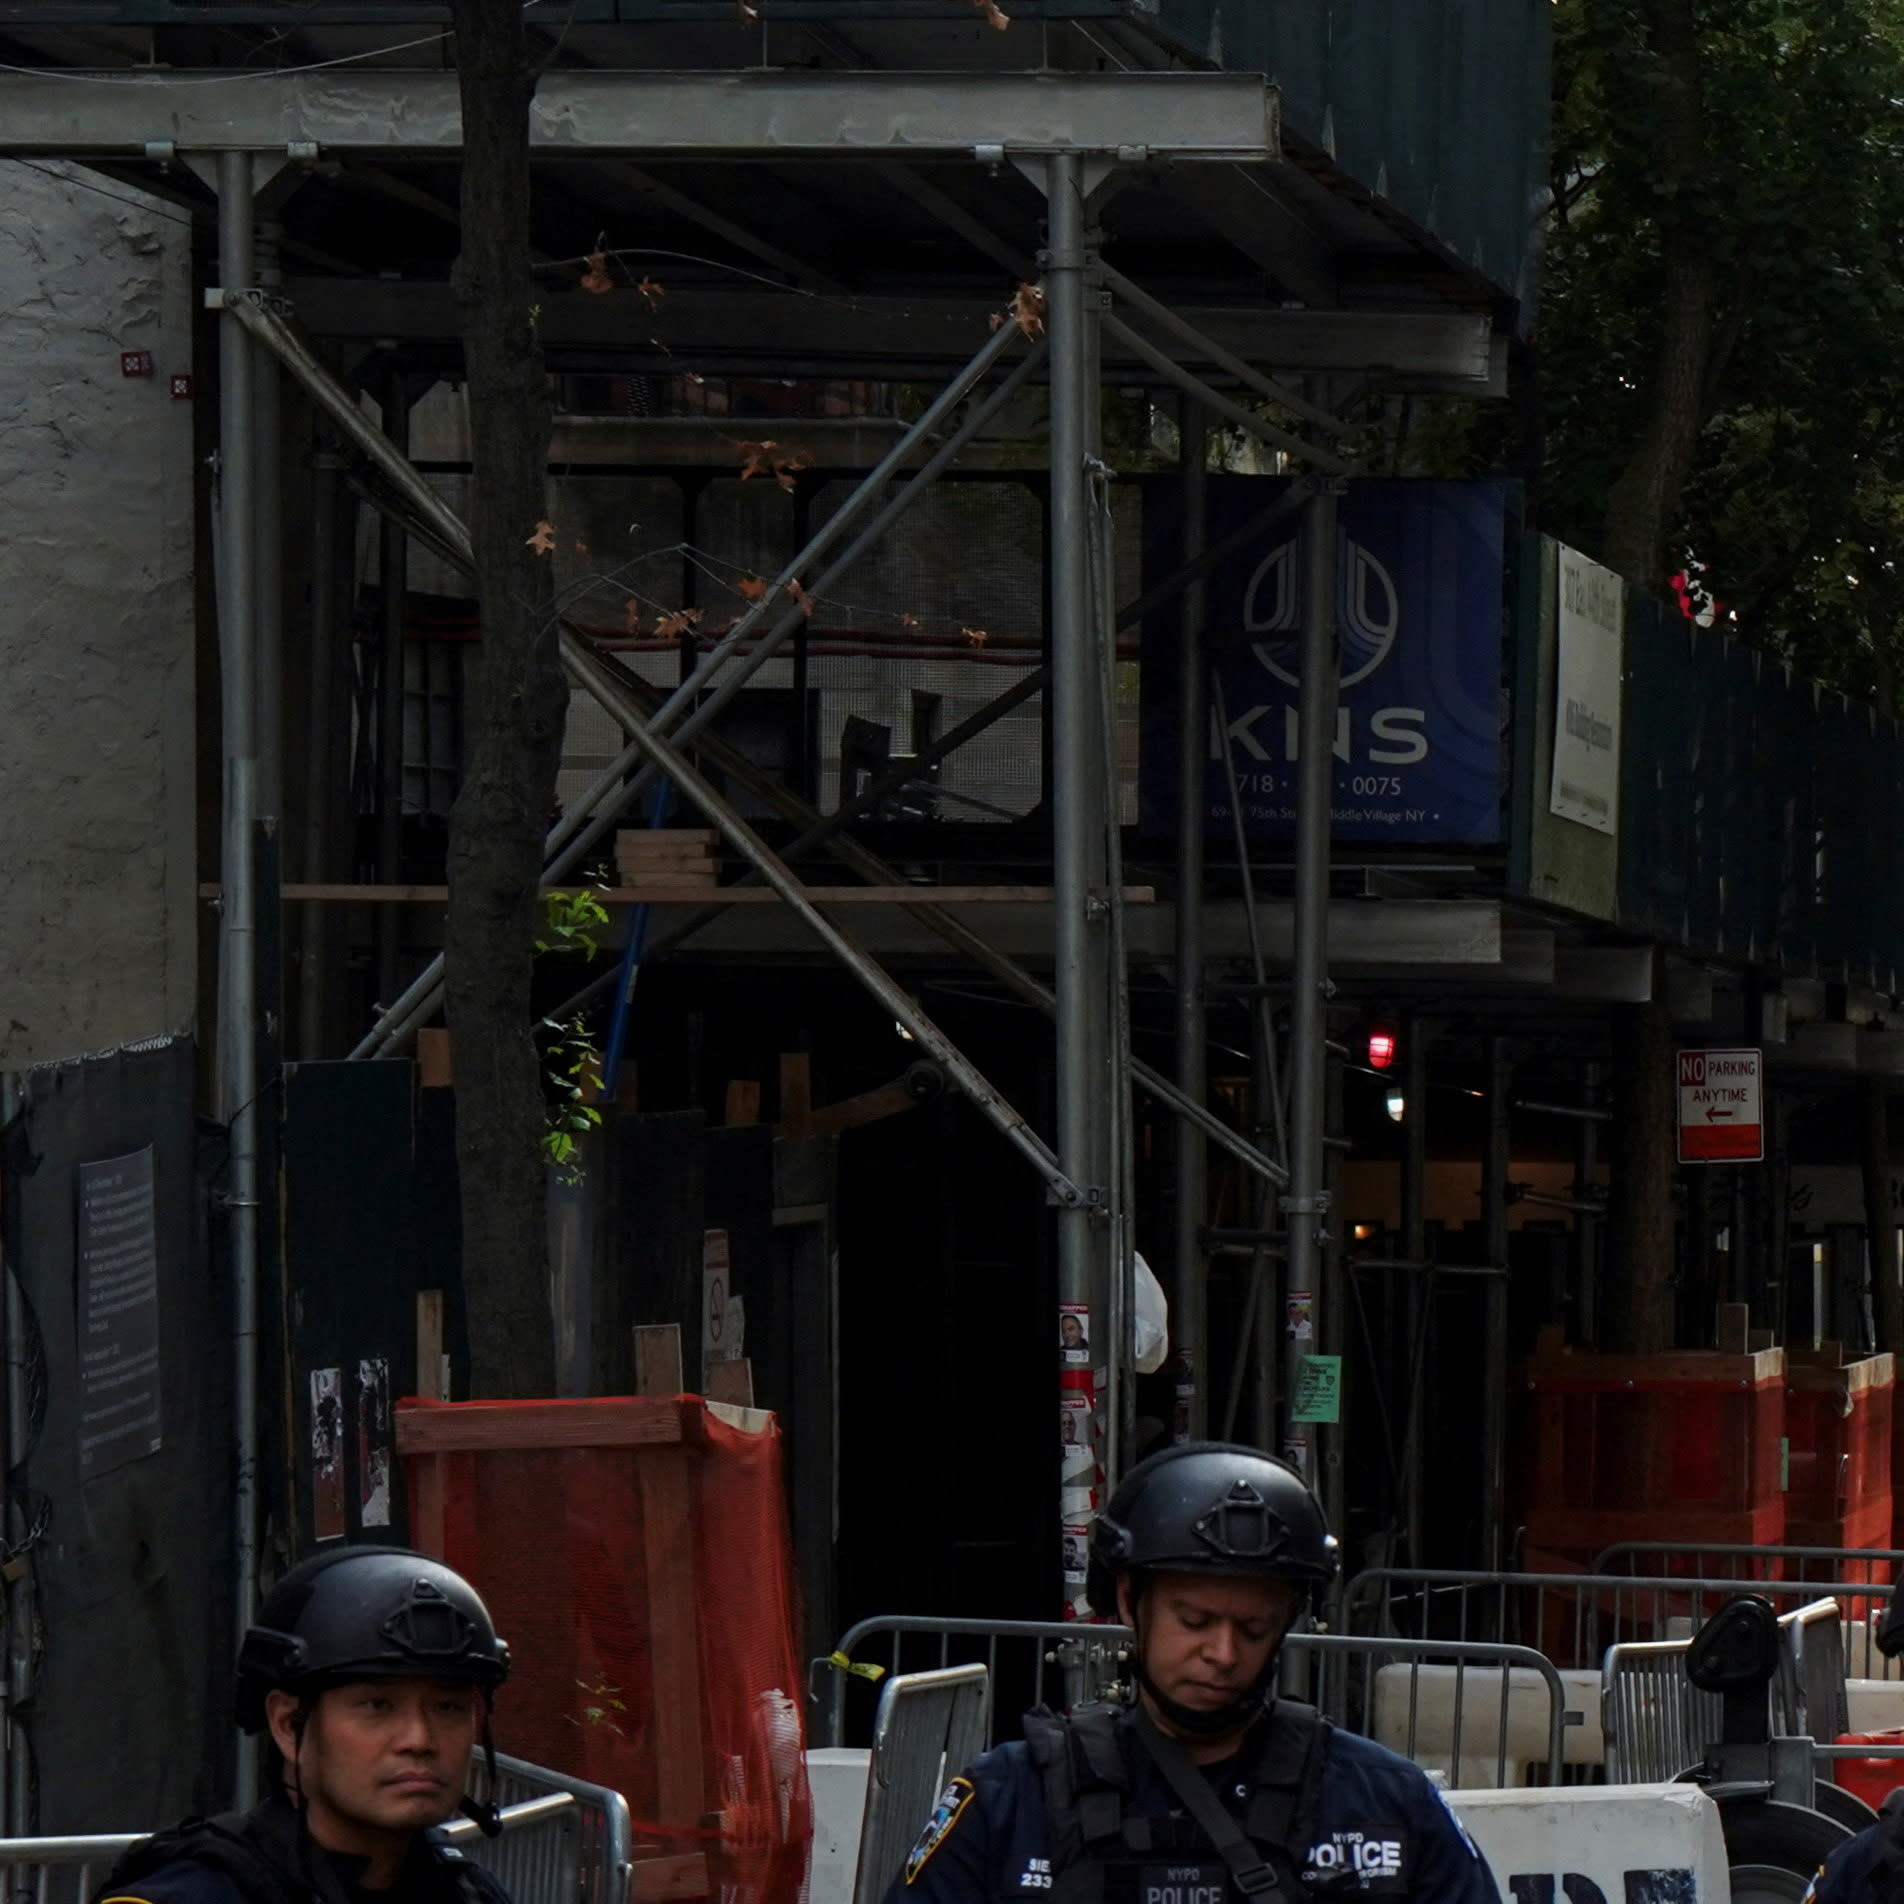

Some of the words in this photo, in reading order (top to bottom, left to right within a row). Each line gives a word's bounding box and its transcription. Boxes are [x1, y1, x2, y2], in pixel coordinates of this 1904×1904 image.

[1236, 773, 1274, 793] 718
[1351, 776, 1402, 795] 0075
[1363, 808, 1402, 824] Village
[1404, 809, 1427, 822] NY
[1681, 1057, 1706, 1081] NO
[1708, 1061, 1756, 1076] PARKING
[1693, 1088, 1749, 1103] ANYTIME
[1331, 1831, 1365, 1844] NYPD
[1305, 1840, 1403, 1871] OLICE
[1166, 1866, 1201, 1881] NYPD
